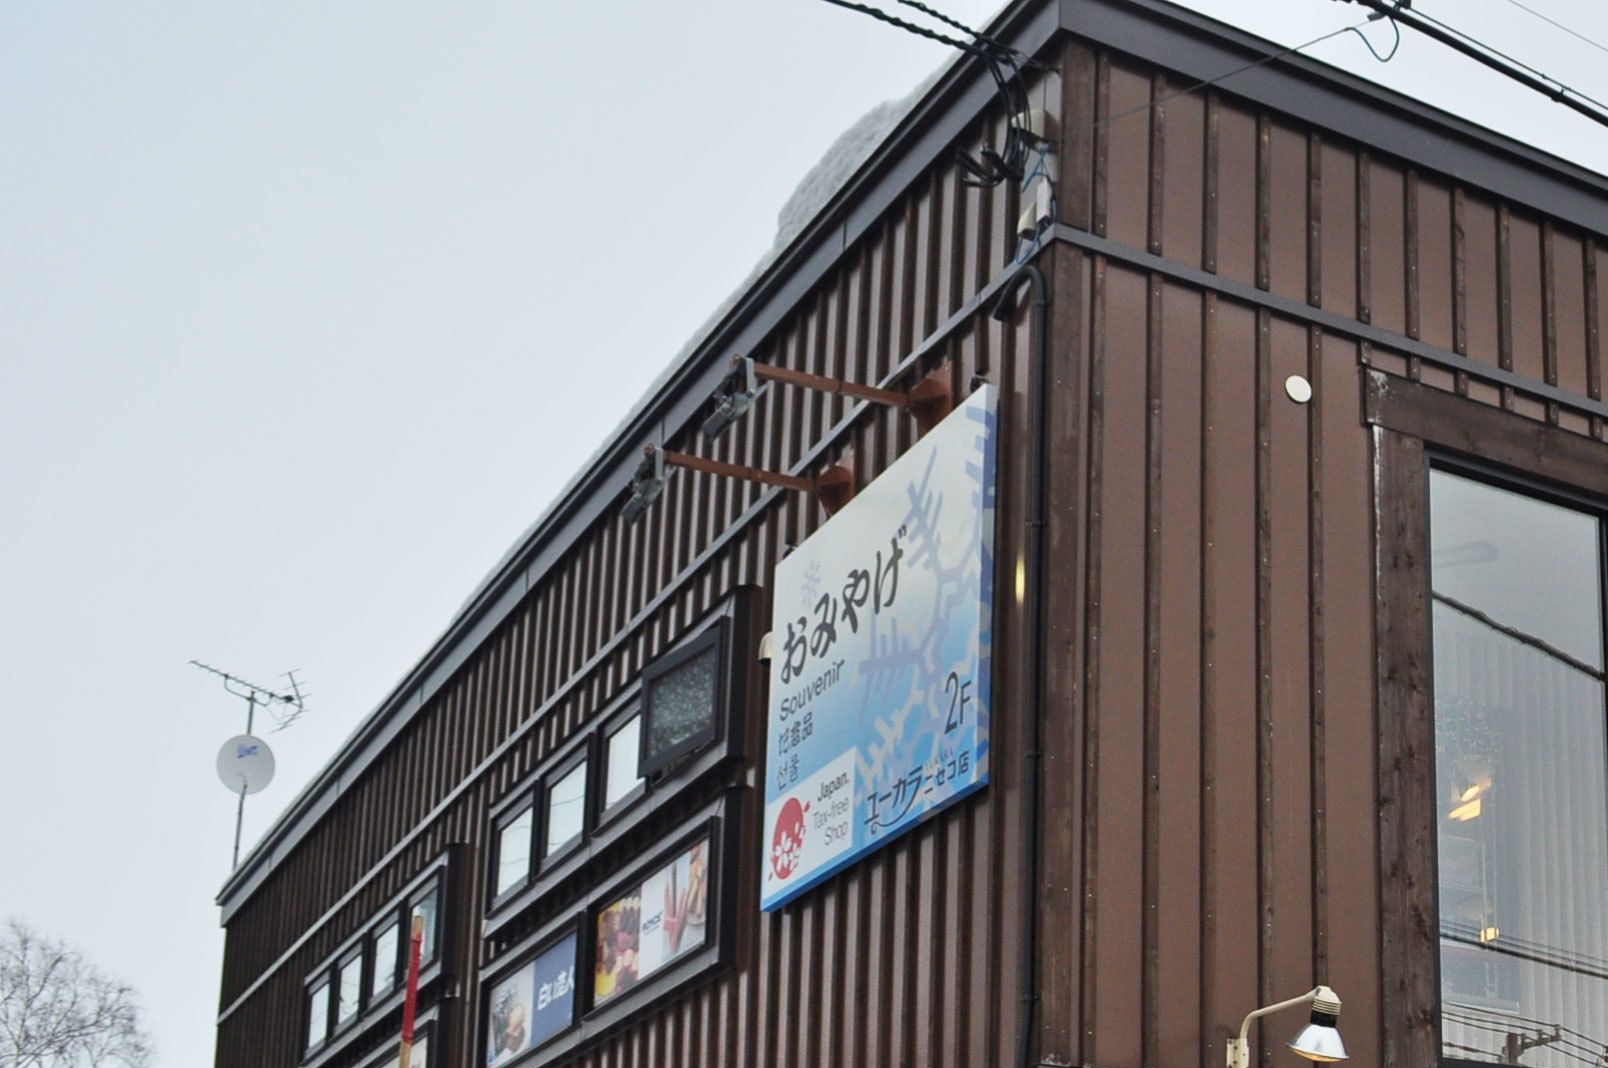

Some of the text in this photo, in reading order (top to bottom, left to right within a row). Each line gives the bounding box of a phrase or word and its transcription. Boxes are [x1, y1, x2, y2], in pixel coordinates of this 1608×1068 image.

[781, 525, 907, 684] おみやげ
[779, 659, 845, 721] Souvenir
[944, 671, 972, 735] 2F
[818, 772, 849, 801] Japan.
[924, 750, 970, 794] ニセコ店
[813, 797, 849, 831] Tax-free
[864, 765, 923, 834] ユーカラ
[825, 820, 848, 846] Shop
